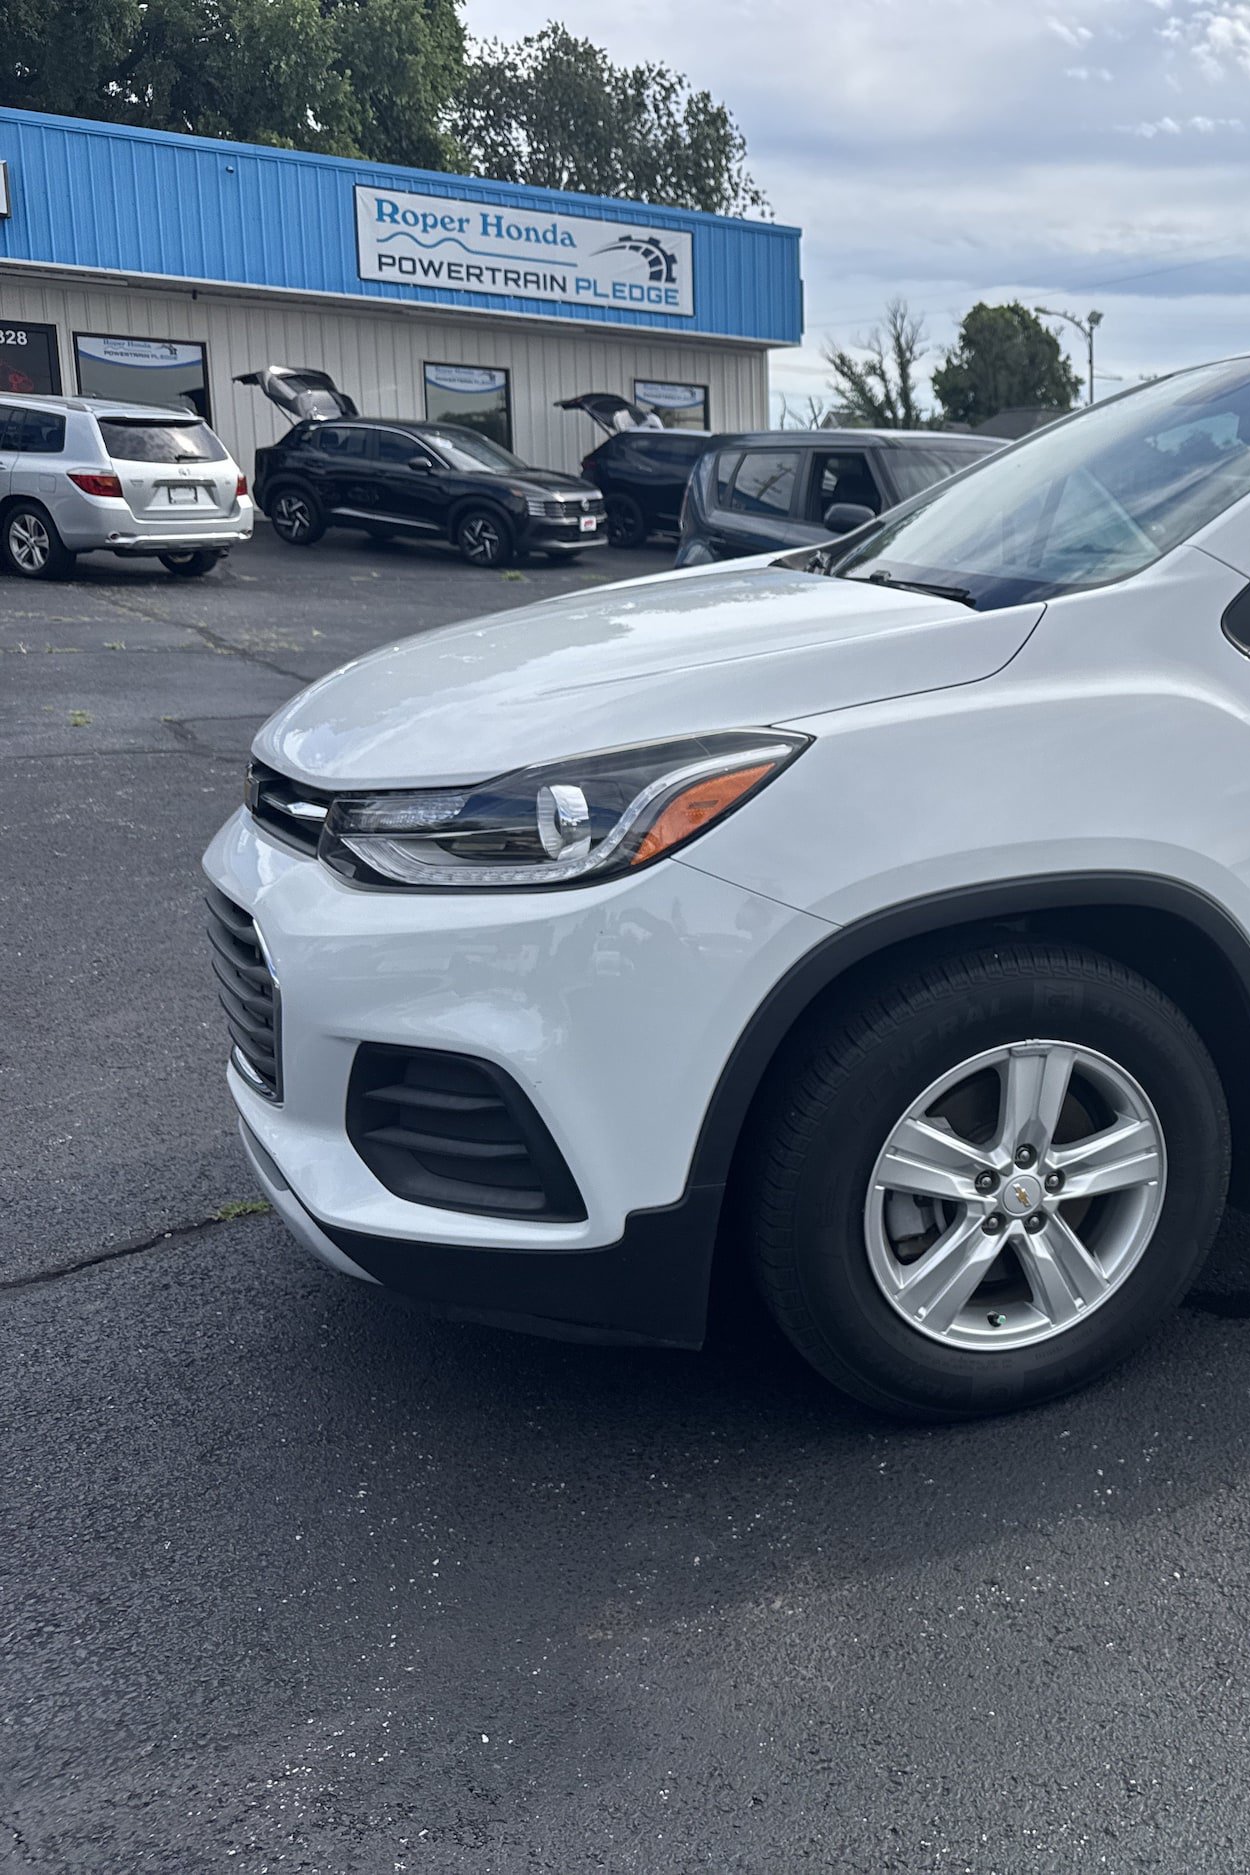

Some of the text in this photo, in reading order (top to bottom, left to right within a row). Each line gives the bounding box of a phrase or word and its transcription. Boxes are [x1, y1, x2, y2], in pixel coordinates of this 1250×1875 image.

[375, 197, 577, 248] Roper Honda
[378, 253, 679, 306] POWERTRAIN PLEDGE
